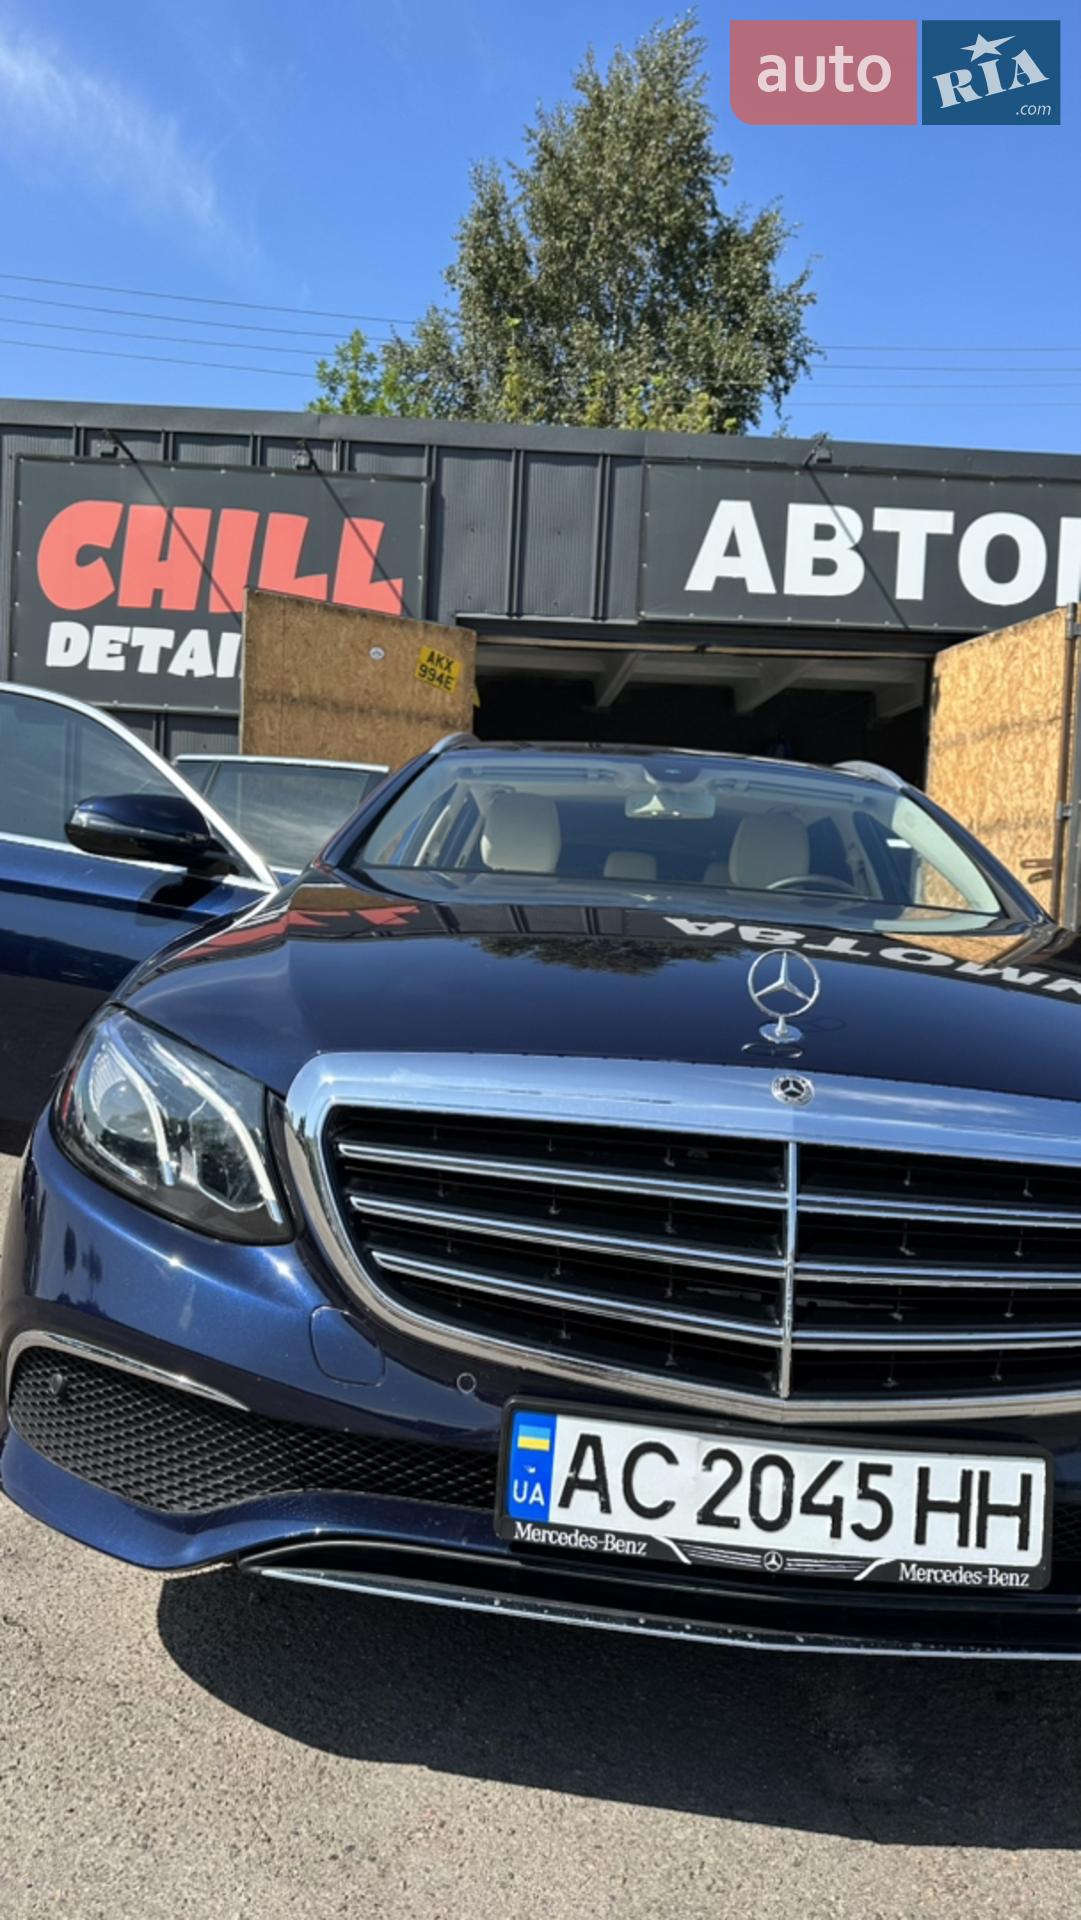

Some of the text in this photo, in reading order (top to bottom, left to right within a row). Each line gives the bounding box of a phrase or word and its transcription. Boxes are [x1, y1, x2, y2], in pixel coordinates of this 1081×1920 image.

[37, 500, 404, 615] CHILL
[684, 499, 1081, 607] АВТО
[46, 621, 243, 678] DETAI
[426, 650, 455, 674] AKX
[417, 664, 455, 691] 994E
[513, 1479, 545, 1507] UA
[514, 1522, 648, 1557] Mercedes-Benz
[899, 1562, 1031, 1588] Mercedes-Benz
